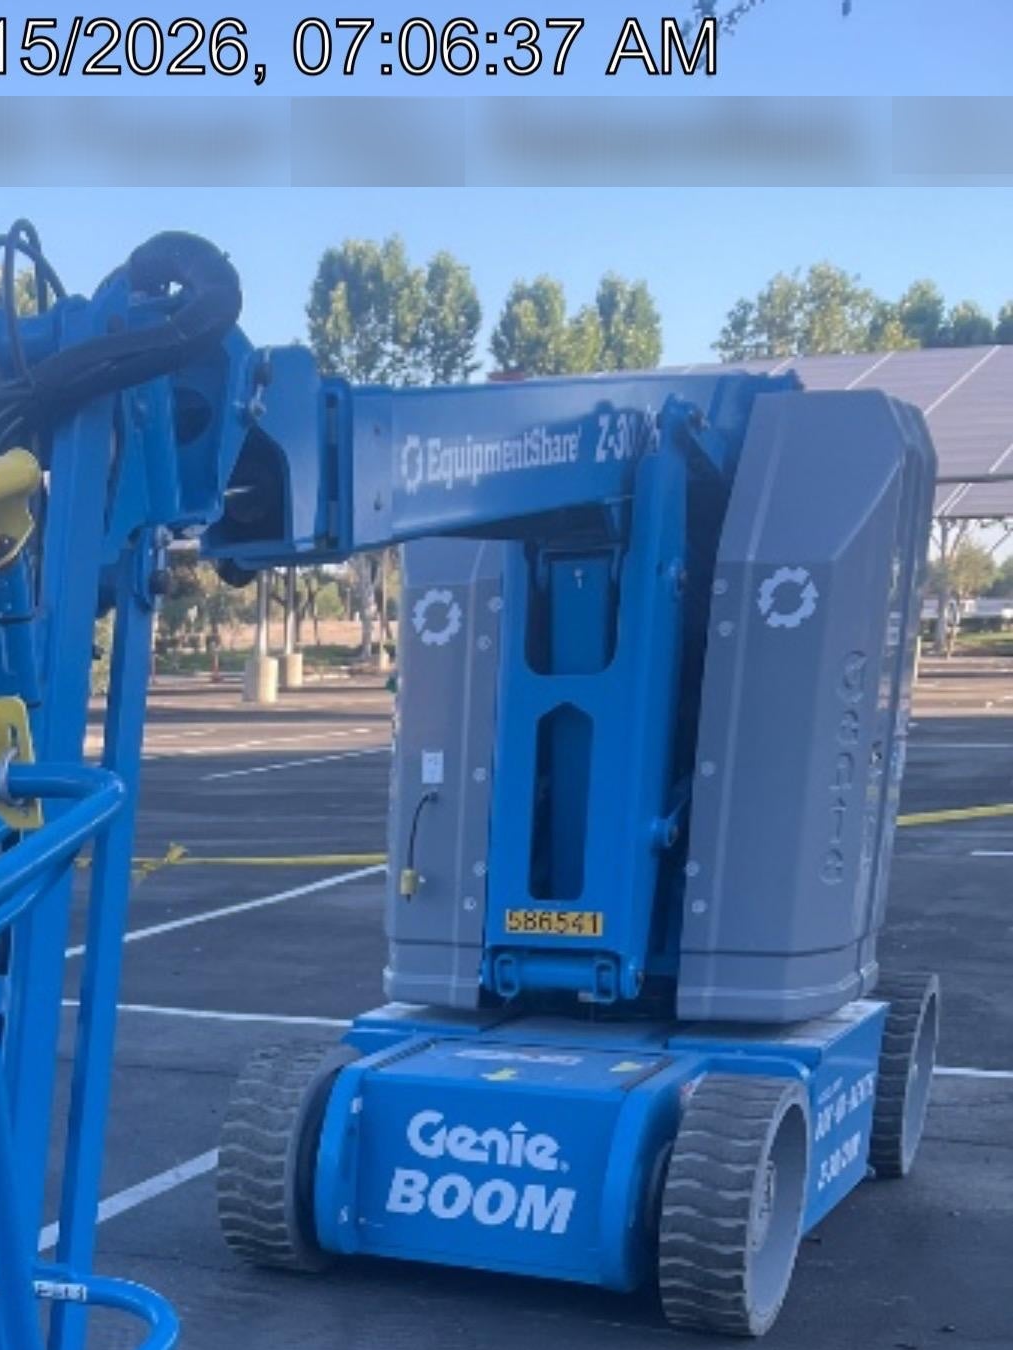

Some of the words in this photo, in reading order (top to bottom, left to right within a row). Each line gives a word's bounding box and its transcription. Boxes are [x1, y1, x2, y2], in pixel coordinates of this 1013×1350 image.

[426, 425, 581, 490] EquipmentShare
[508, 910, 598, 934] 586541
[406, 1109, 562, 1171] Genie
[385, 1167, 577, 1234] BOOM
